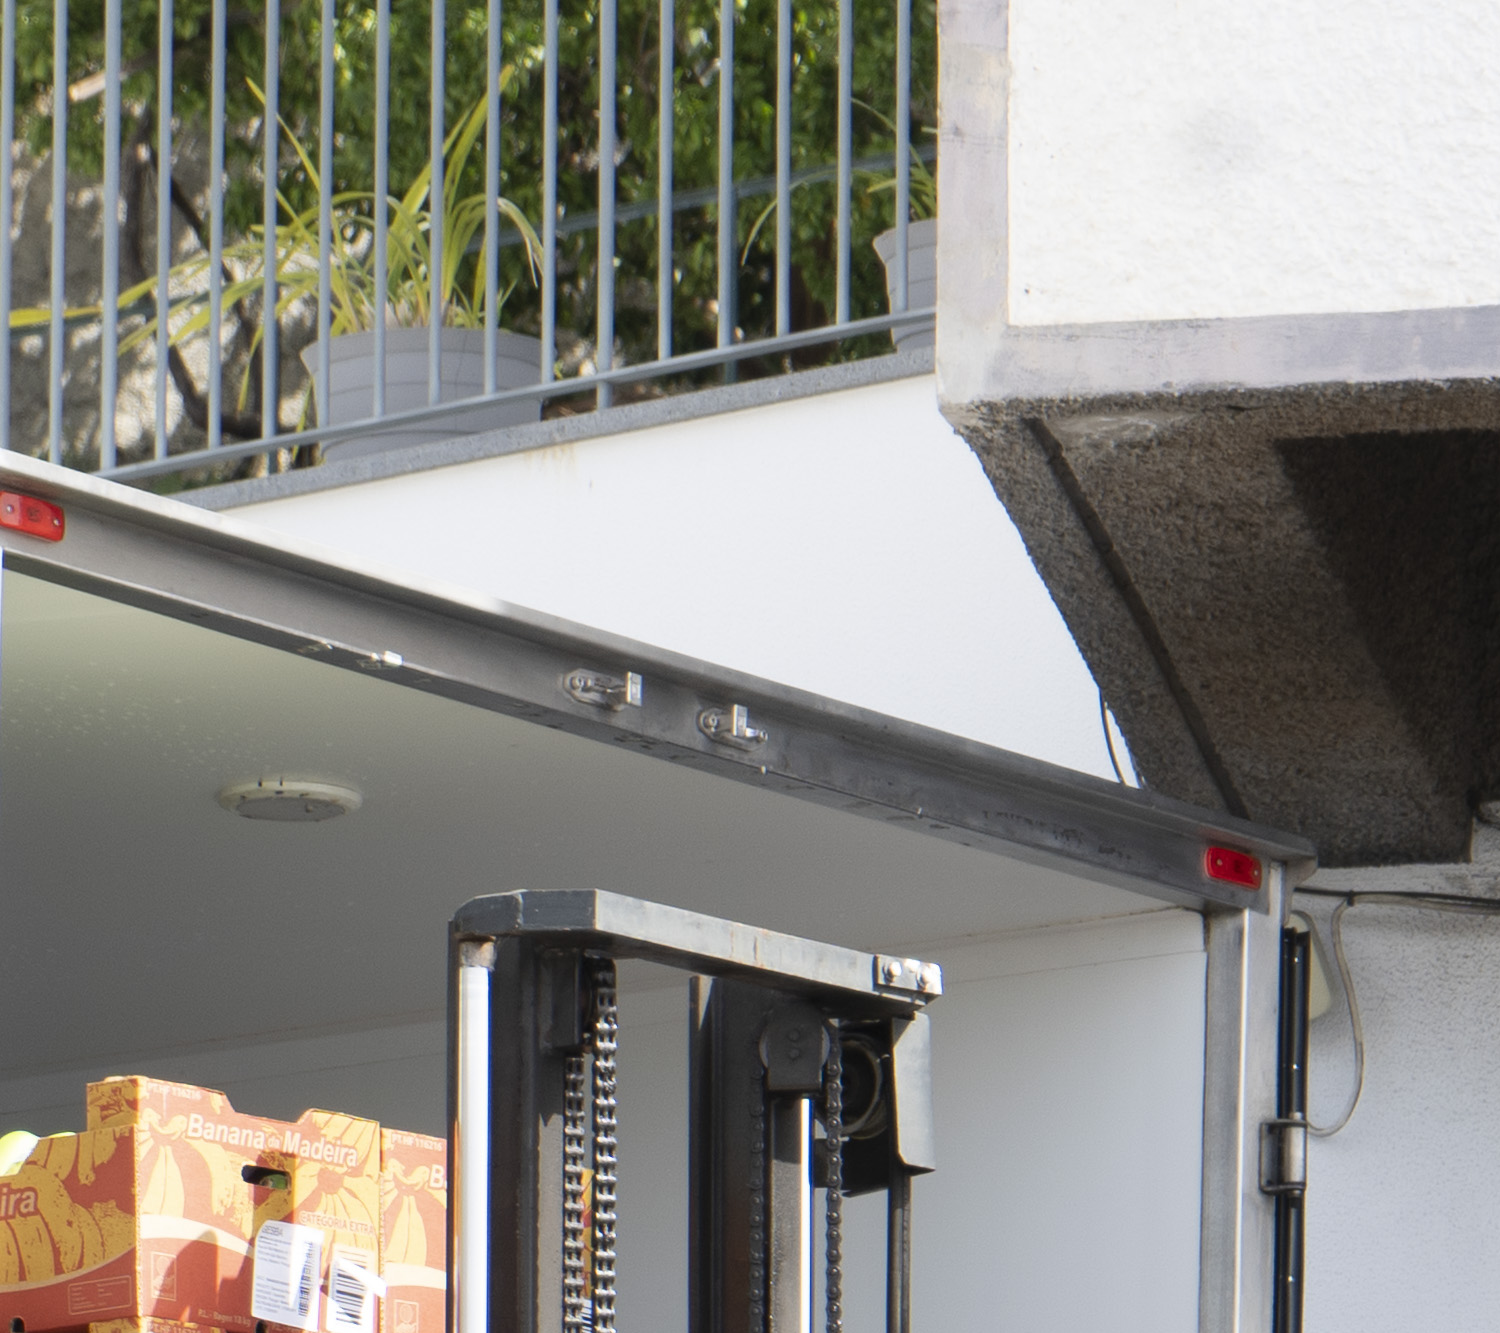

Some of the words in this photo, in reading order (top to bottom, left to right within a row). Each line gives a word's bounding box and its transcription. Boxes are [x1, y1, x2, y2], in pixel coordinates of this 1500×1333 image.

[186, 1113, 265, 1150] Banana
[284, 1130, 358, 1168] Madeira
[414, 1137, 443, 1152] 116216
[299, 1211, 347, 1231] CATEGORIA
[349, 1217, 374, 1234] EXTRA
